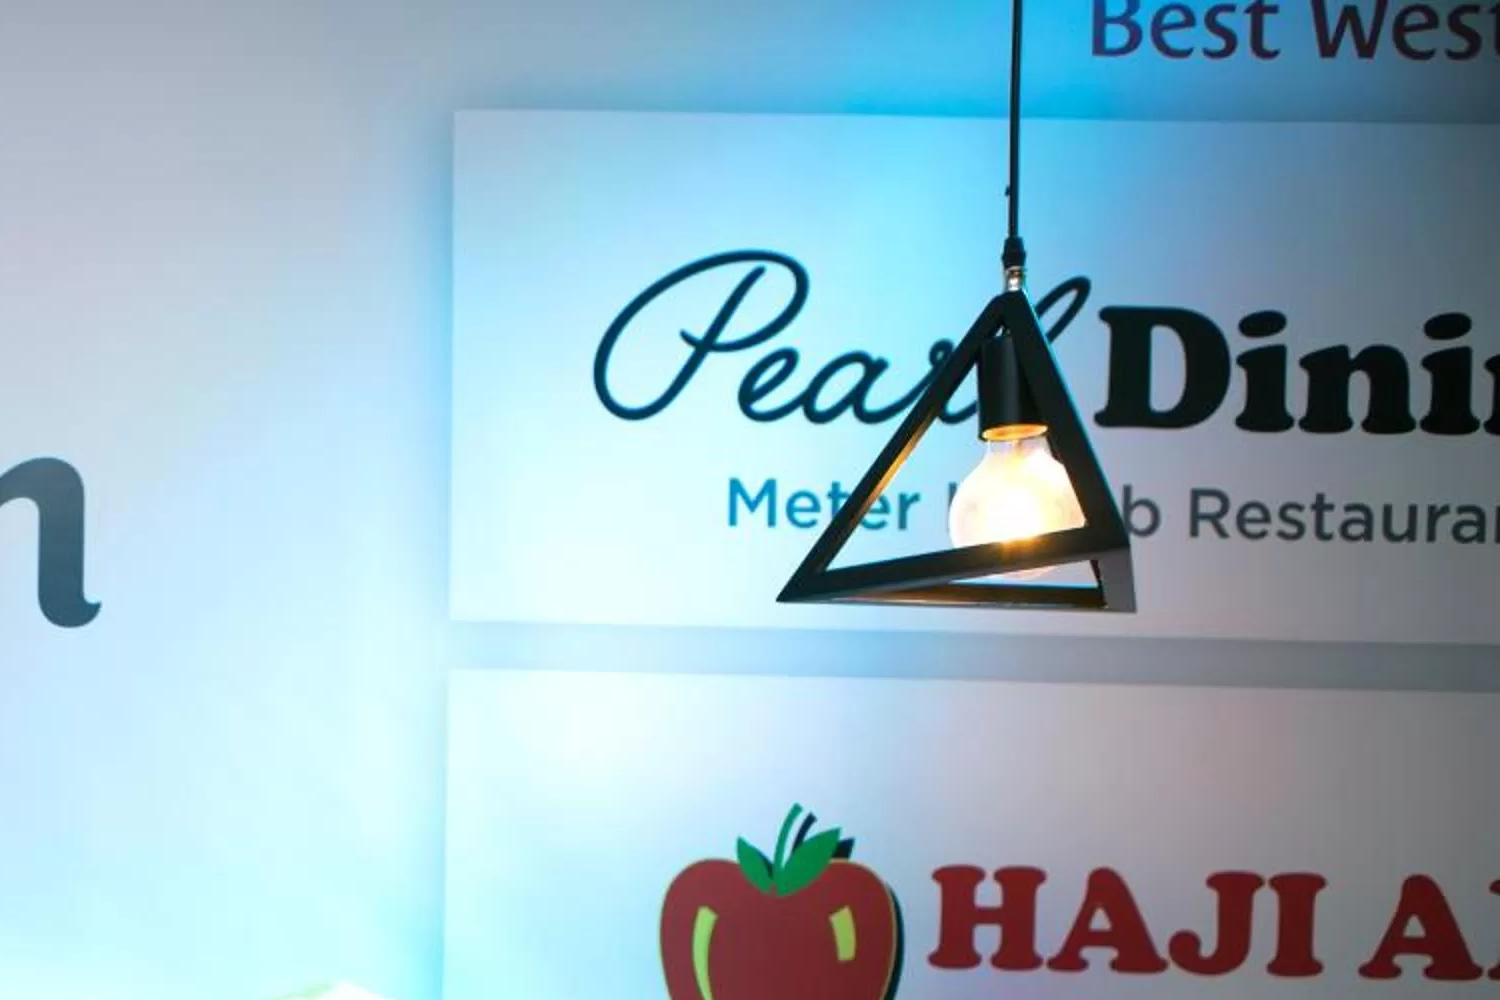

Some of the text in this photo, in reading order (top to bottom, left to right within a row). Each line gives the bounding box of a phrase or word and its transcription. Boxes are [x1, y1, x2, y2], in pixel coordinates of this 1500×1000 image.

[1091, 0, 1281, 60] Best
[1094, 305, 1500, 437] Dini
[1188, 487, 1500, 544] Restaura
[927, 864, 1500, 981] HAJI A
